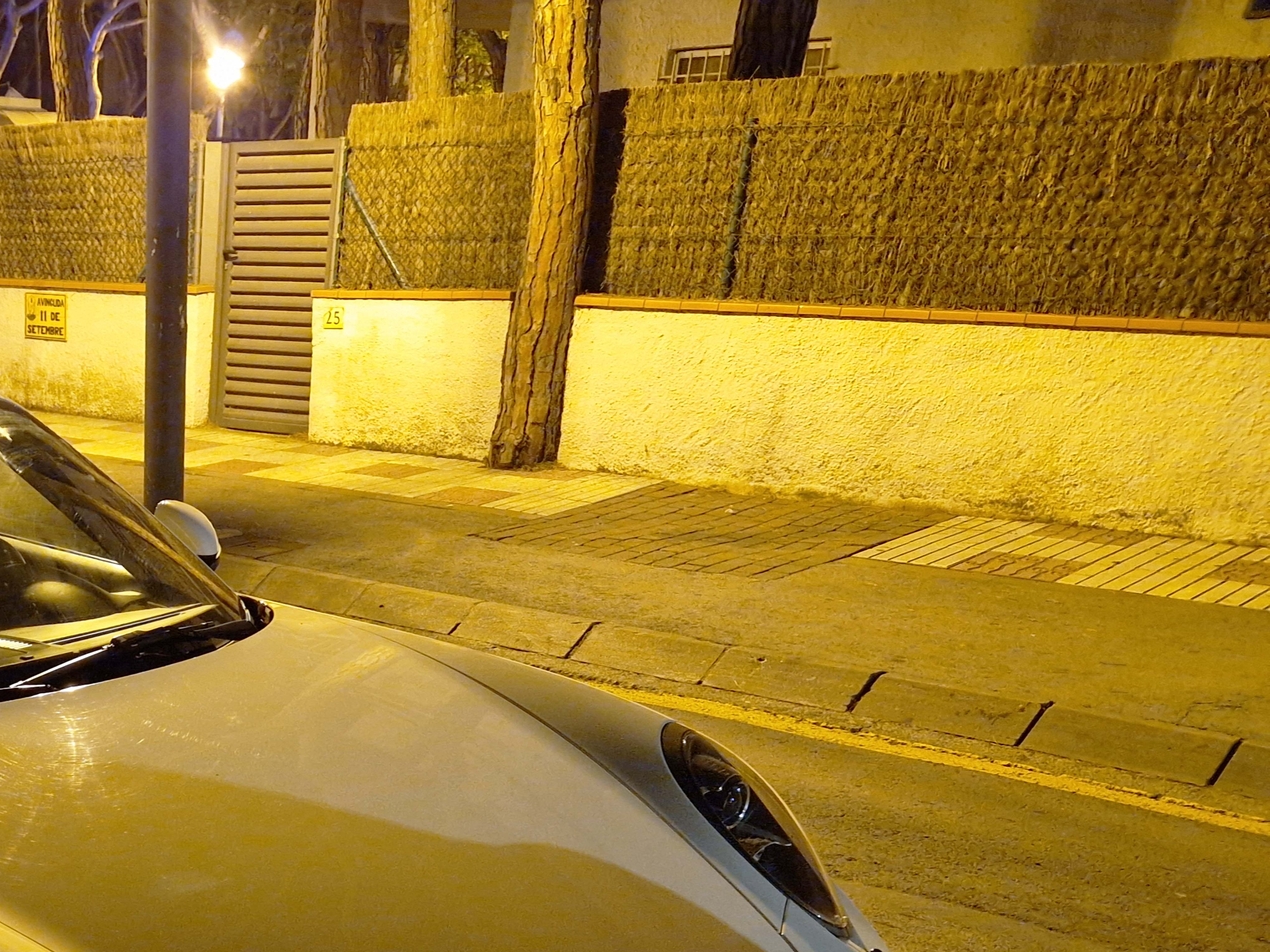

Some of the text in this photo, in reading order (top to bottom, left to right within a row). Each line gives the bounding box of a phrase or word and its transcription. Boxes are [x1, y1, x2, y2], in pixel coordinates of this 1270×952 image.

[36, 297, 65, 308] AVINGUDA
[50, 311, 61, 322] DE
[326, 310, 341, 325] 25
[27, 324, 64, 336] SETEMBRE
